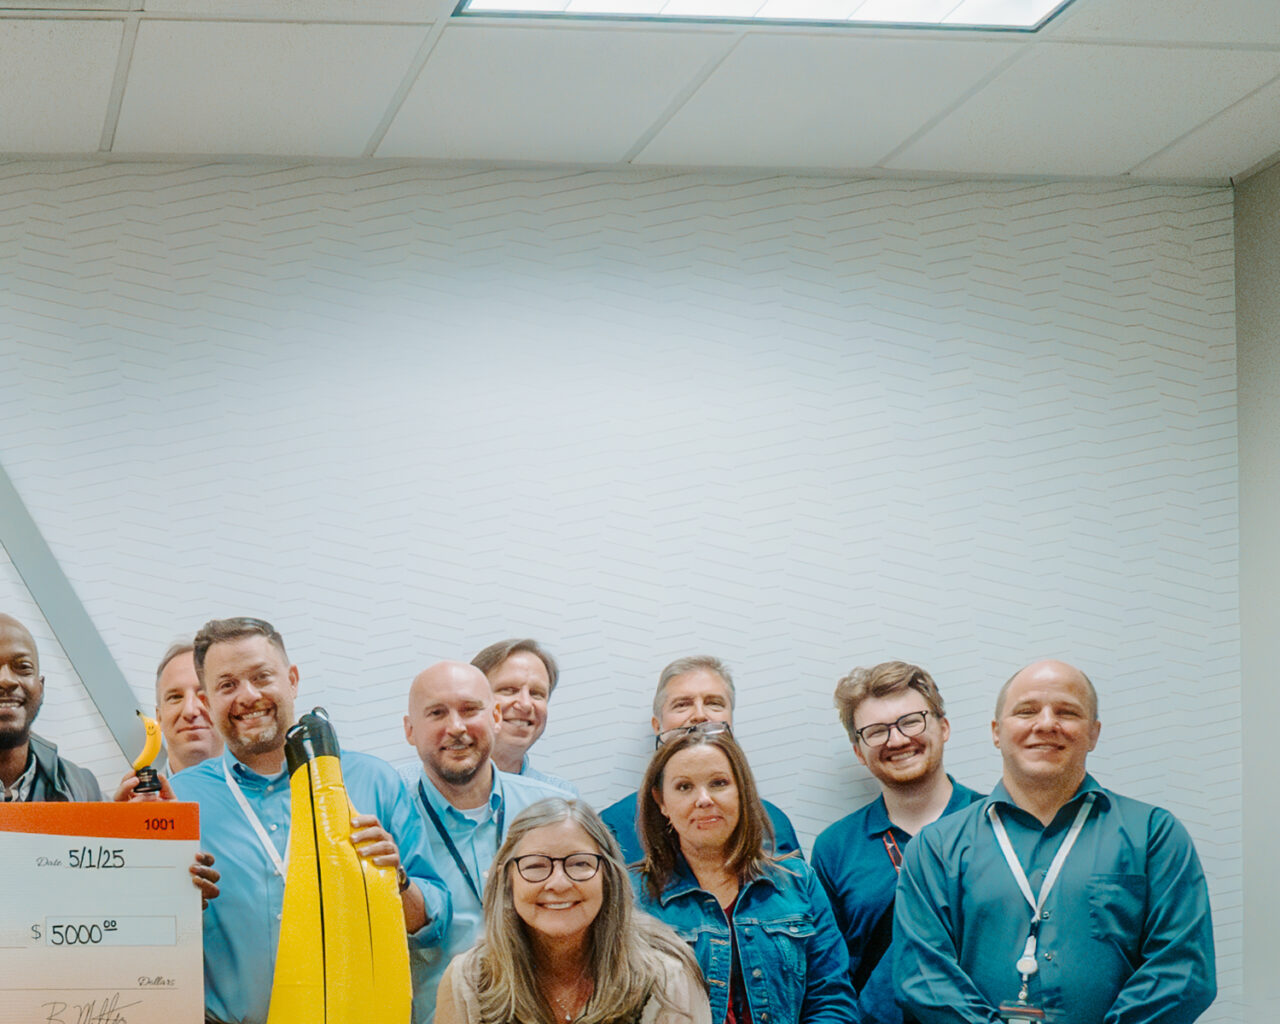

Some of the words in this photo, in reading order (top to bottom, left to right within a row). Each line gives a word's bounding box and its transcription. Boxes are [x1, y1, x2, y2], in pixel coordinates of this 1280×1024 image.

[144, 818, 175, 830] 1001
[69, 846, 125, 869] 5/1/25
[31, 924, 42, 940] $
